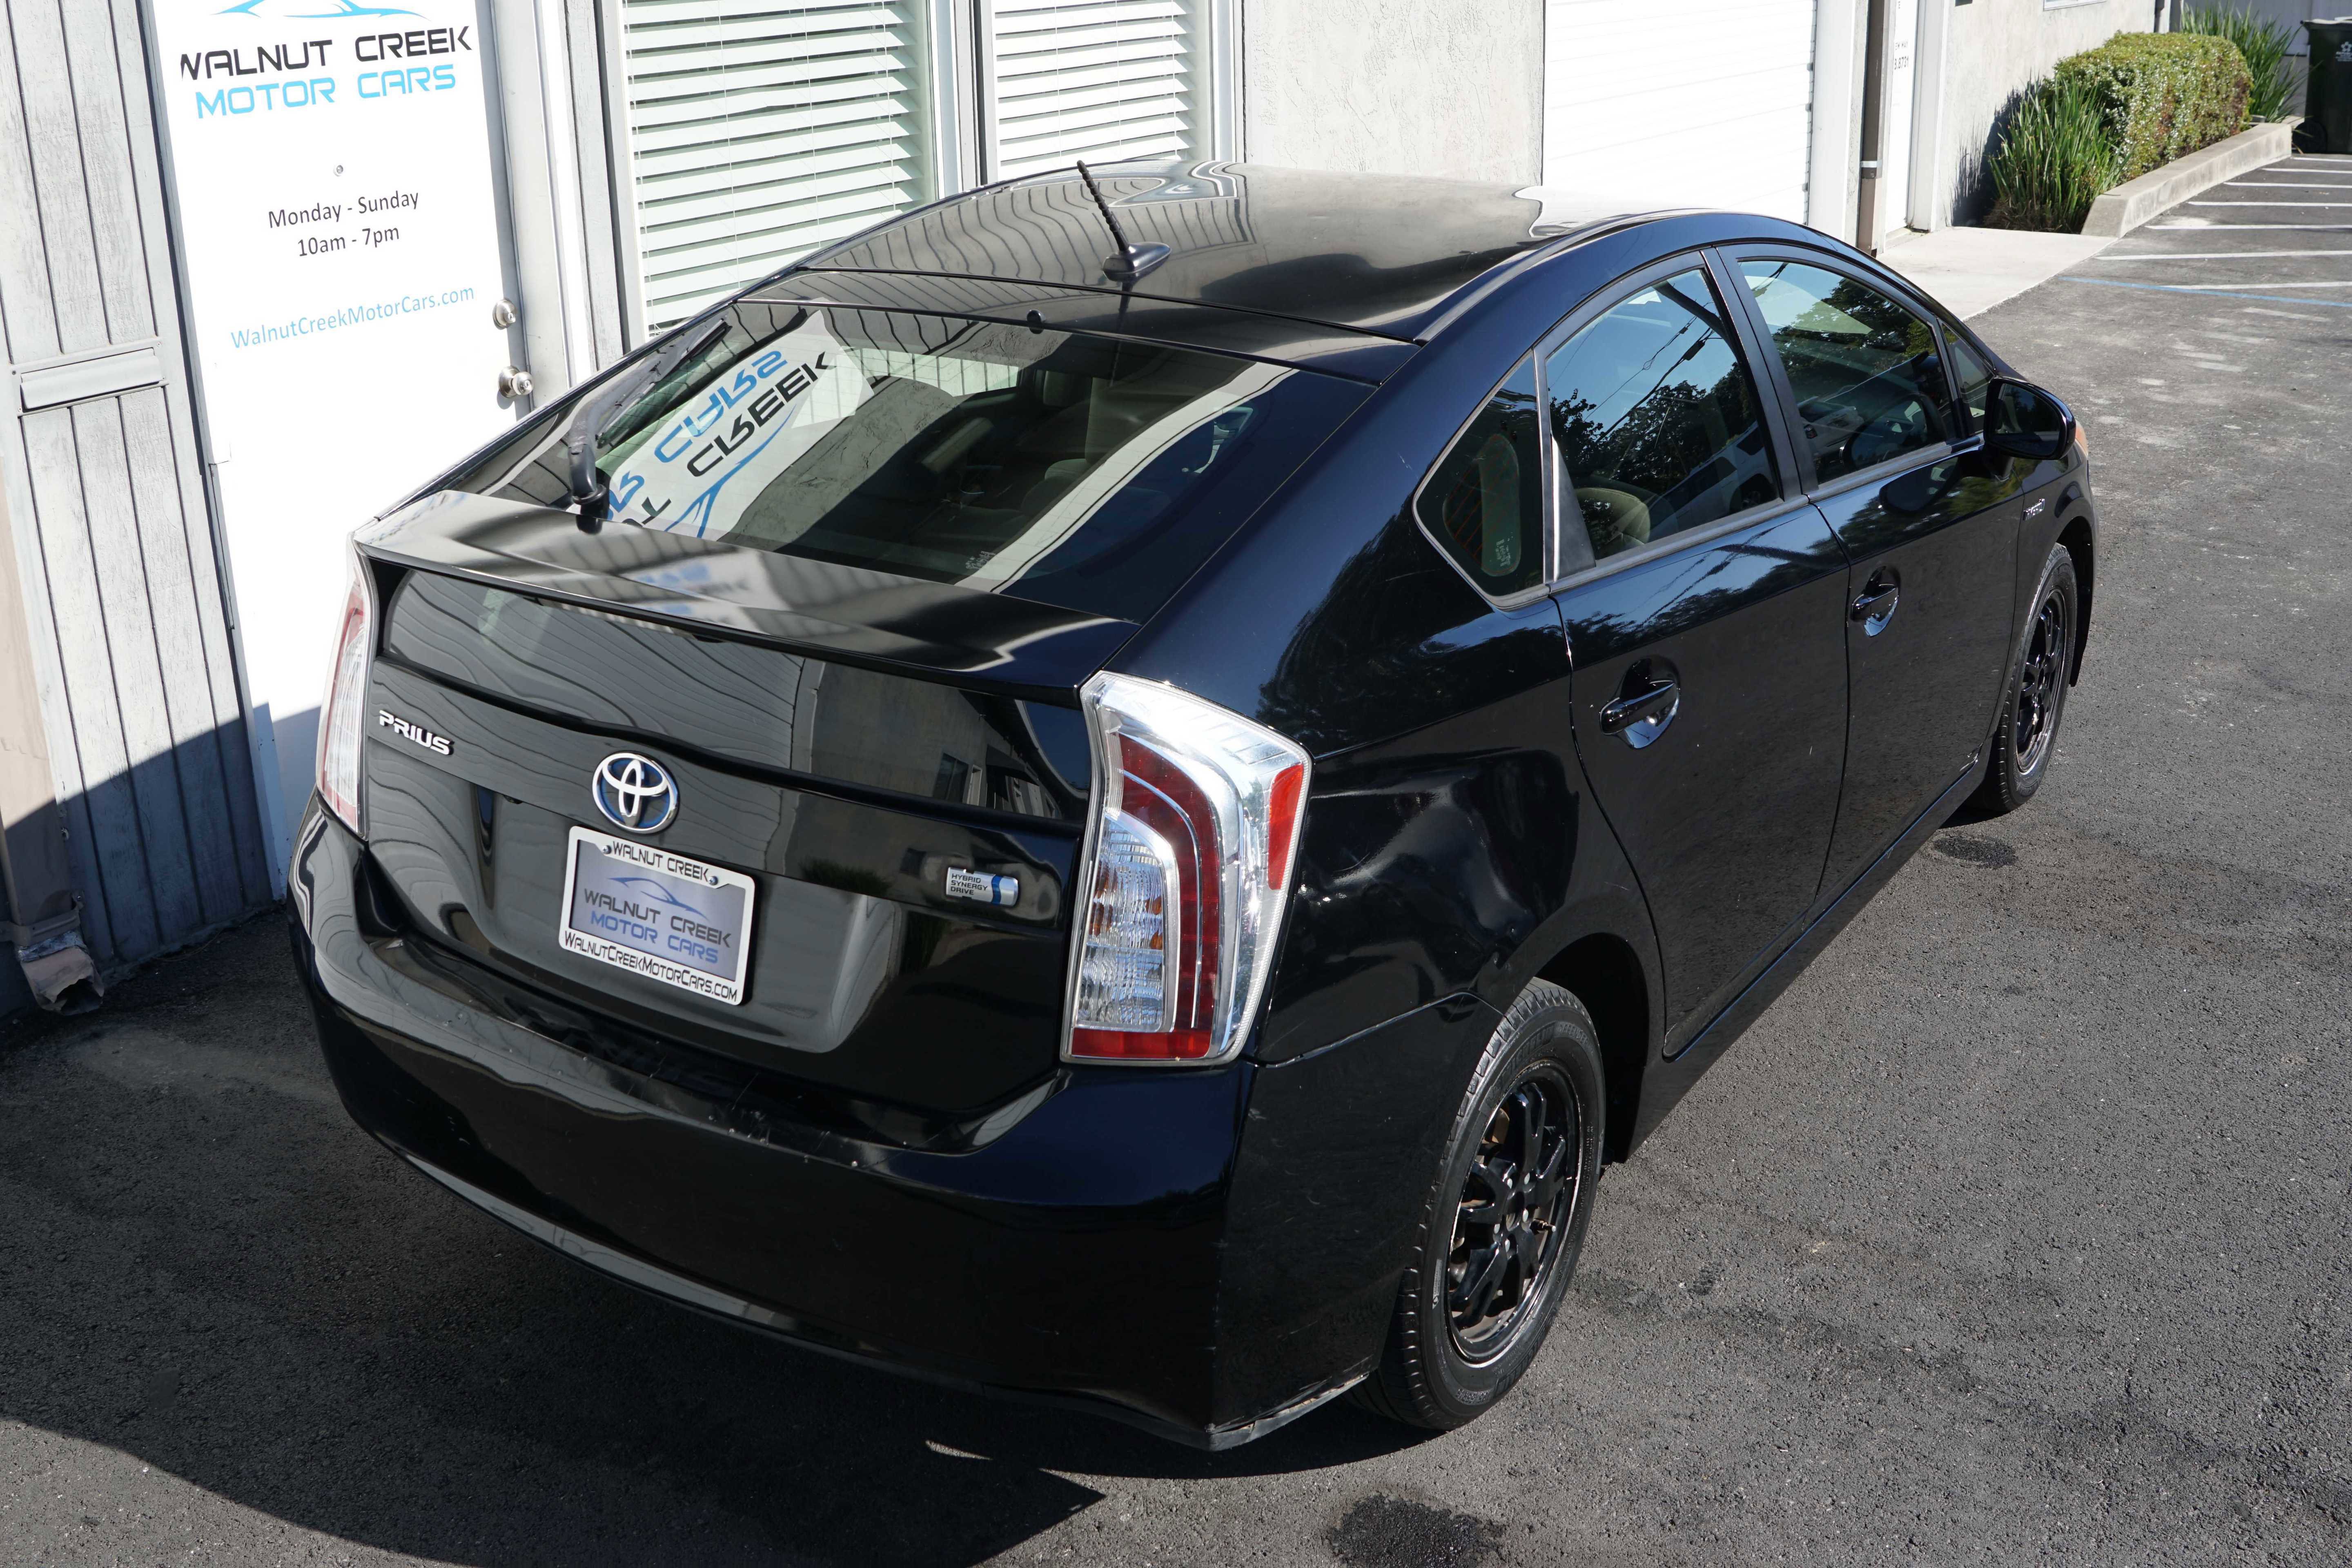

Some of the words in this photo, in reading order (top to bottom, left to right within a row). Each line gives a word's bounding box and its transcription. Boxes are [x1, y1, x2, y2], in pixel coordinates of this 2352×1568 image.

[355, 26, 472, 62] CREEK
[196, 78, 335, 118] MOTOR
[357, 64, 456, 98] CARS
[269, 203, 341, 229] Monday
[358, 190, 419, 214] Sunday
[298, 237, 346, 257] 10am
[362, 227, 399, 248] 7pm
[231, 286, 474, 349] WalnutCreekMotorCars.com
[379, 710, 451, 755] PRIUS
[612, 841, 663, 867] WALNUT
[667, 858, 709, 882] CREEK
[952, 873, 981, 884] HYBRID
[951, 880, 988, 891] SYNERGY
[951, 886, 974, 895] DRIVE
[584, 888, 661, 924] WALNUT
[670, 915, 732, 949] CREEK
[590, 910, 658, 944] MOTOR
[667, 934, 719, 964] CARS
